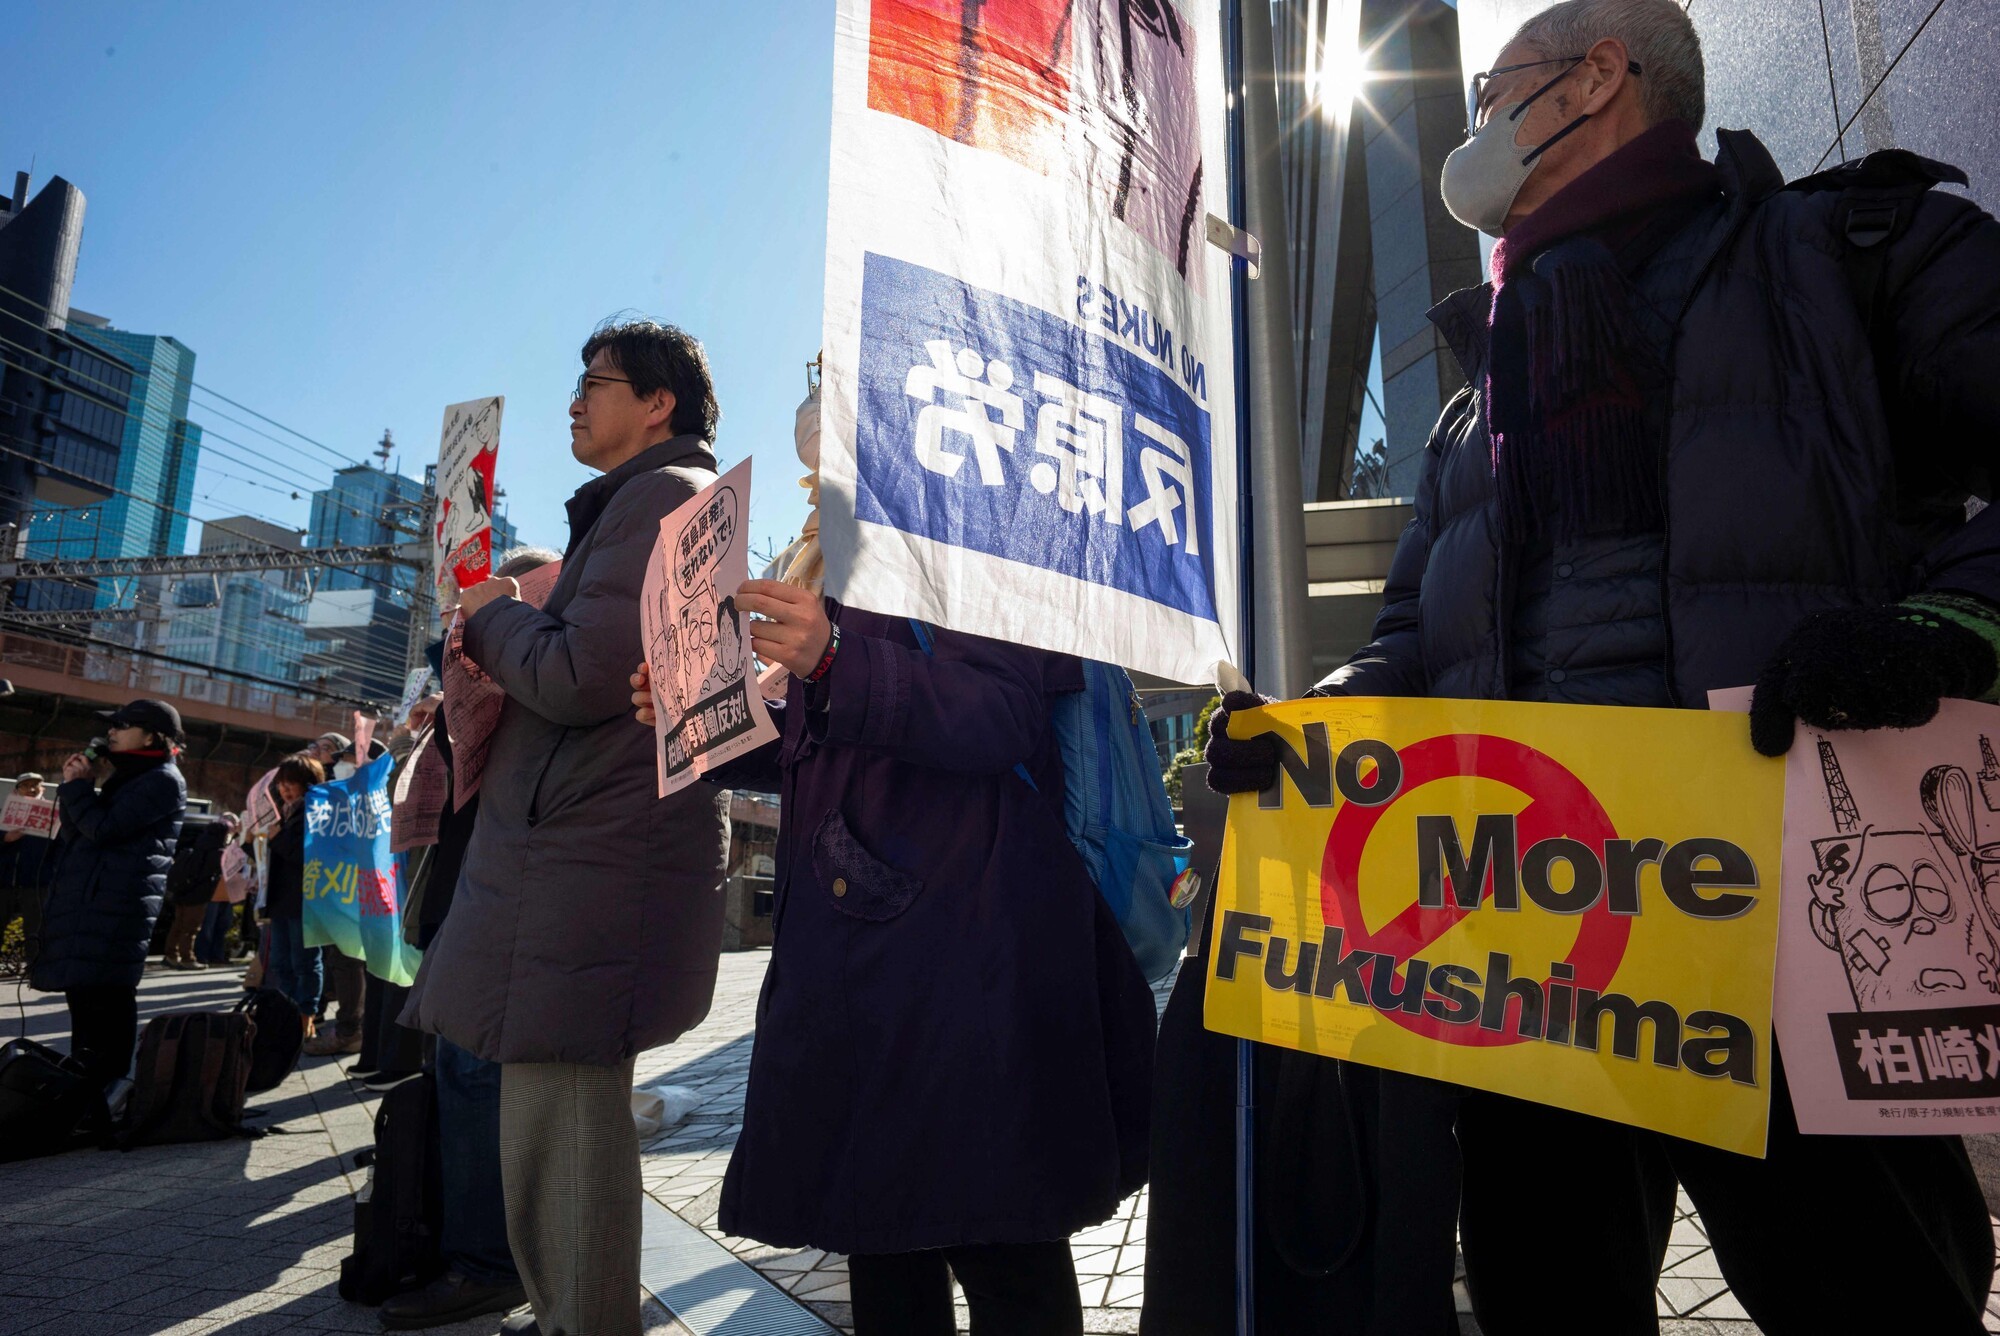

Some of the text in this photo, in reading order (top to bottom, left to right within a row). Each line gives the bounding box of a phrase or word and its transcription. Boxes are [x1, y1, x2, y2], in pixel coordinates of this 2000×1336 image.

[1252, 720, 1404, 809] No
[1416, 813, 1761, 921] More
[1214, 908, 1759, 1089] Fukushima
